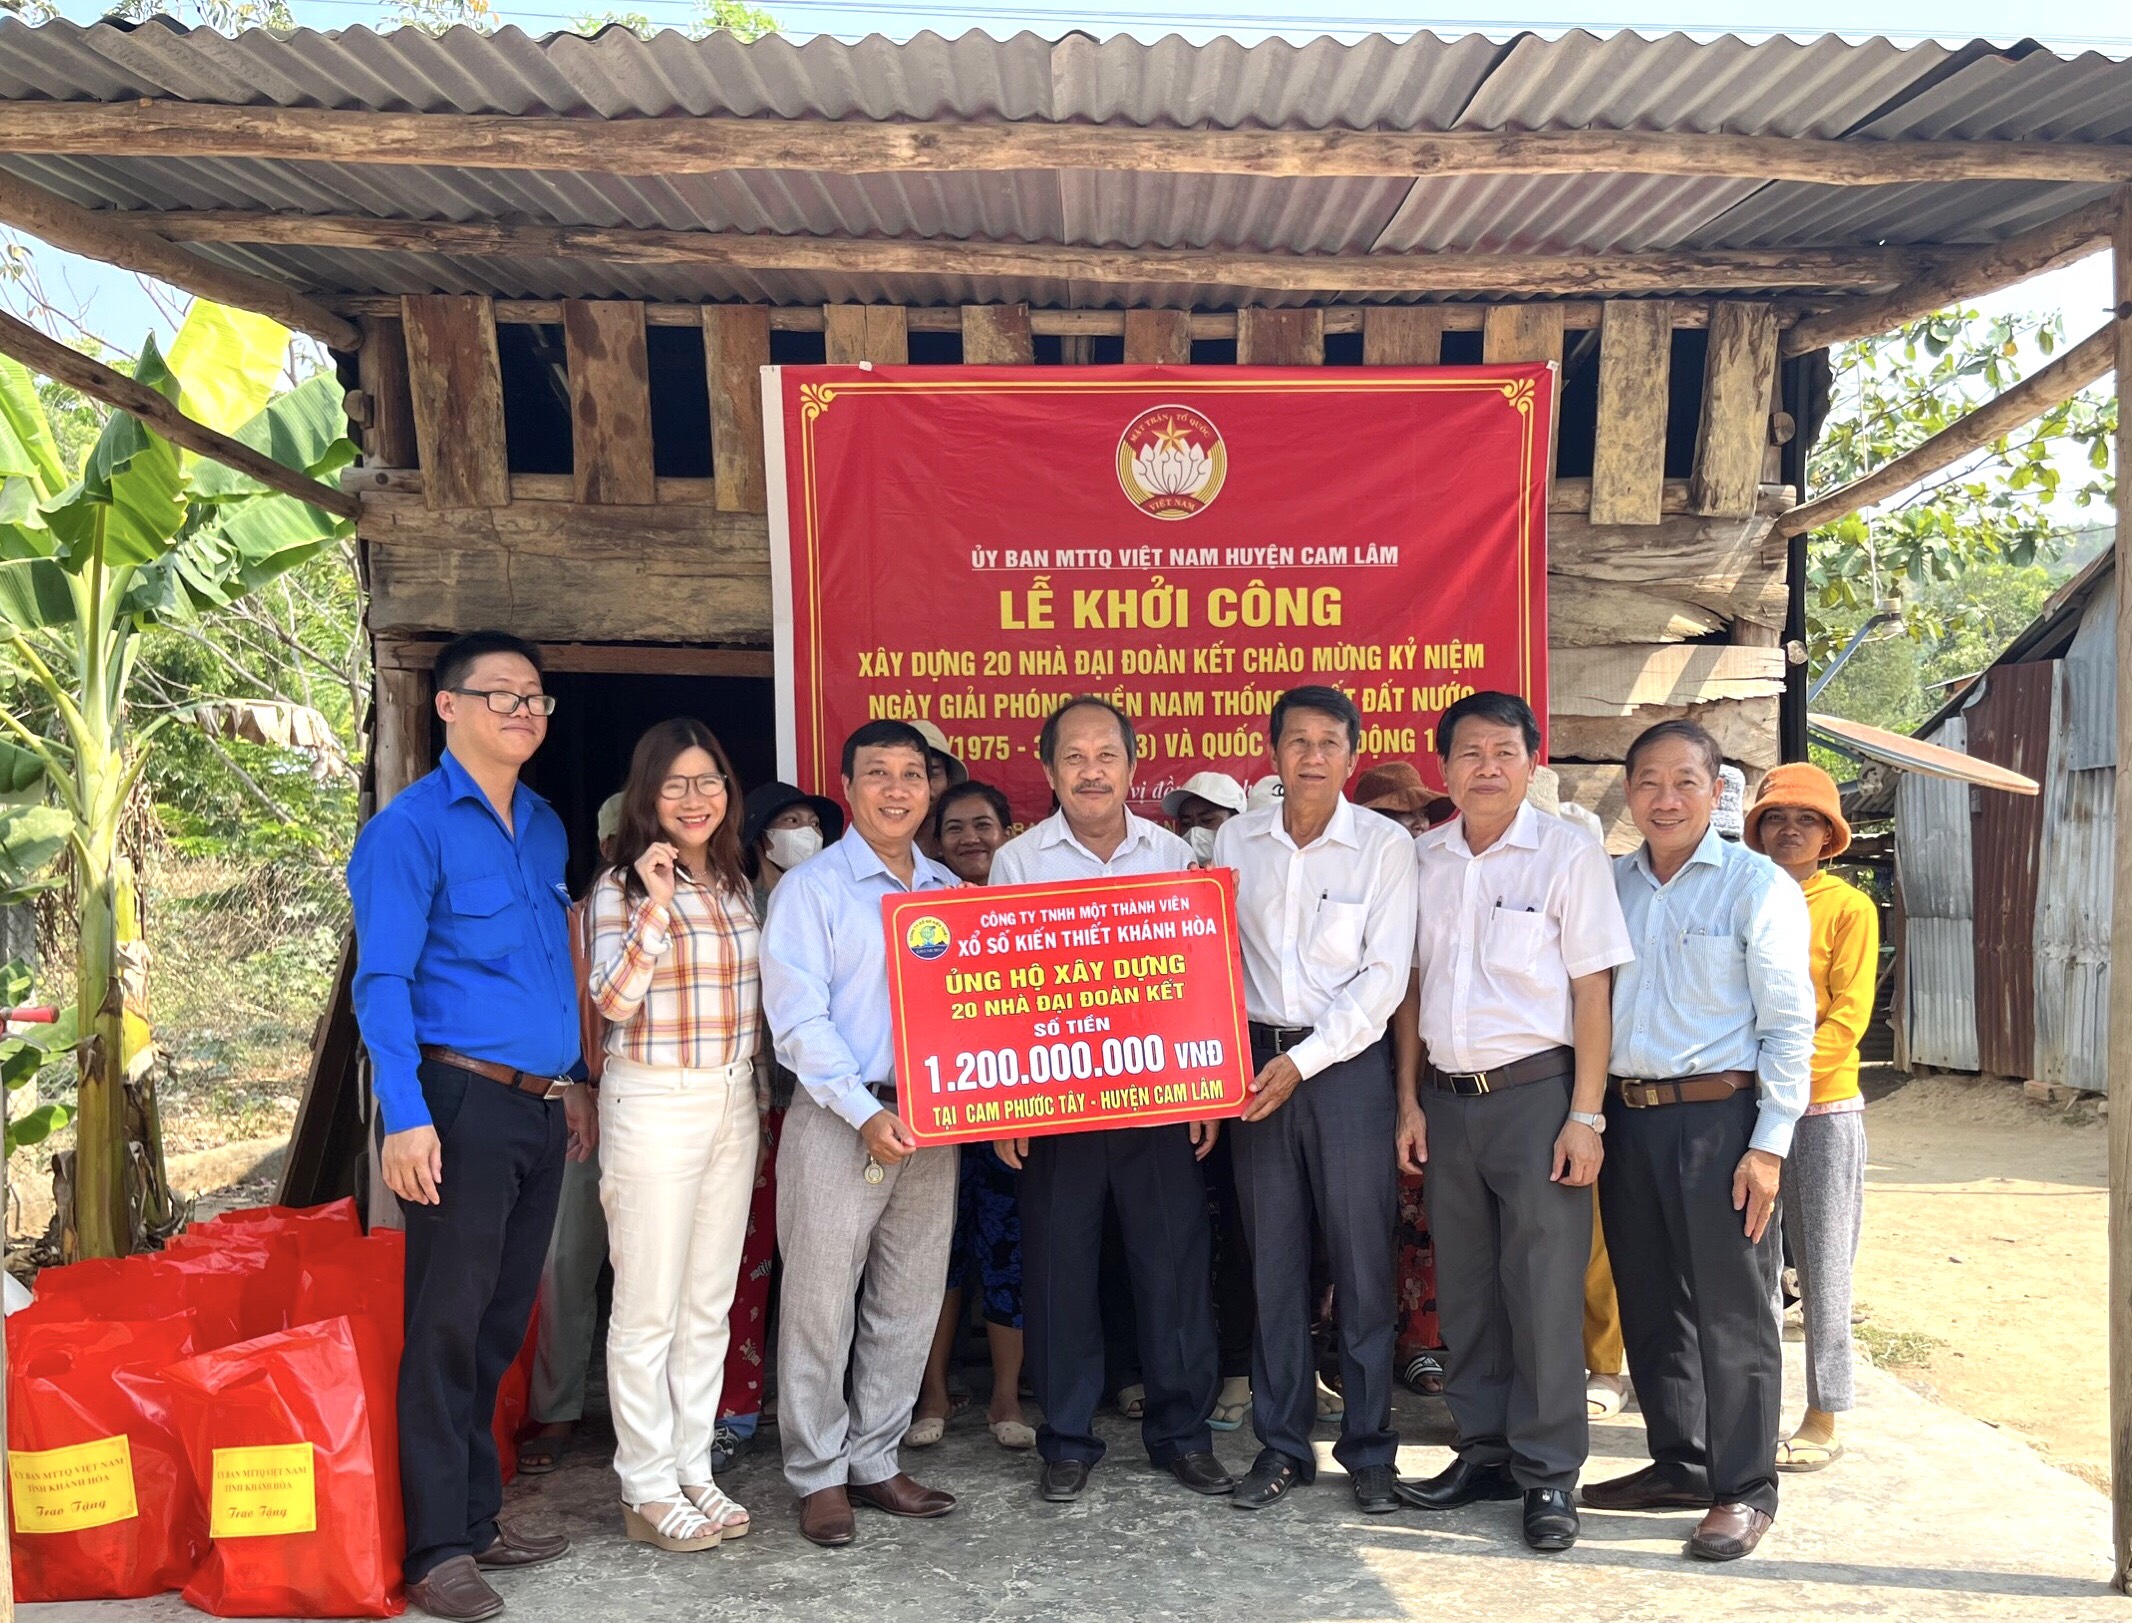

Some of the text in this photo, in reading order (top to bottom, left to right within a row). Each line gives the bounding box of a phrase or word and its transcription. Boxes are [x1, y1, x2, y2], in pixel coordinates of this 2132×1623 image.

[1149, 499, 1196, 511] VIỆT NAM
[971, 543, 1399, 570] ỦY BAN MTTQ VIỆT NAM HUYỆN CAM LÂM
[999, 575, 1342, 630] LỄ KHỞI CÔNG
[858, 637, 1485, 682] XÂY DỰNG 20 NHÀ ĐẠI ĐOÀN KẾT CHÀO MỪNG KỶ NIỆM
[869, 689, 932, 720] NGÀY
[939, 685, 986, 719] GIẢI
[1150, 691, 1204, 717] NAM
[1362, 679, 1404, 713] ĐẤT
[1164, 728, 1195, 758] VÀ
[1202, 723, 1264, 758] QUỐC
[1131, 781, 1146, 803] vị
[980, 895, 1190, 928] CÔNG TY TNHH MỘT THÀNH VIÊN
[958, 930, 981, 957] XỔ
[986, 929, 1010, 954] SỐ
[1015, 926, 1057, 952] KIẾN
[1061, 921, 1111, 948] THIẾT
[1117, 920, 1176, 943] KHÁNH
[1181, 917, 1217, 937] HÒA
[1009, 962, 1045, 991] HỘ
[1054, 958, 1104, 985] XÂY
[1113, 954, 1186, 982] DỰNG
[951, 978, 1185, 1020] 20 NHÀ ĐẠI ĐOÀN KẾT
[1033, 1016, 1060, 1037] SỐ
[923, 1034, 1224, 1094] 1.200.000.000 VNĐ
[933, 1106, 957, 1130] TẠI
[966, 1101, 1000, 1123] CAM
[1004, 1096, 1054, 1120] PHƯỚC
[1058, 1090, 1086, 1114] TÂY
[1101, 1085, 1150, 1112] HUYỆN
[1153, 1085, 1188, 1105] CAM
[1191, 1077, 1224, 1101] LÂM
[25, 1471, 40, 1480] BAN
[43, 1468, 72, 1479] MTTQ
[101, 1458, 124, 1468] NAM
[48, 1478, 85, 1492] KHÁNH
[286, 1466, 307, 1475] NAM
[35, 1499, 106, 1517] Trao Tặng
[228, 1505, 287, 1519] Trao Tặng
